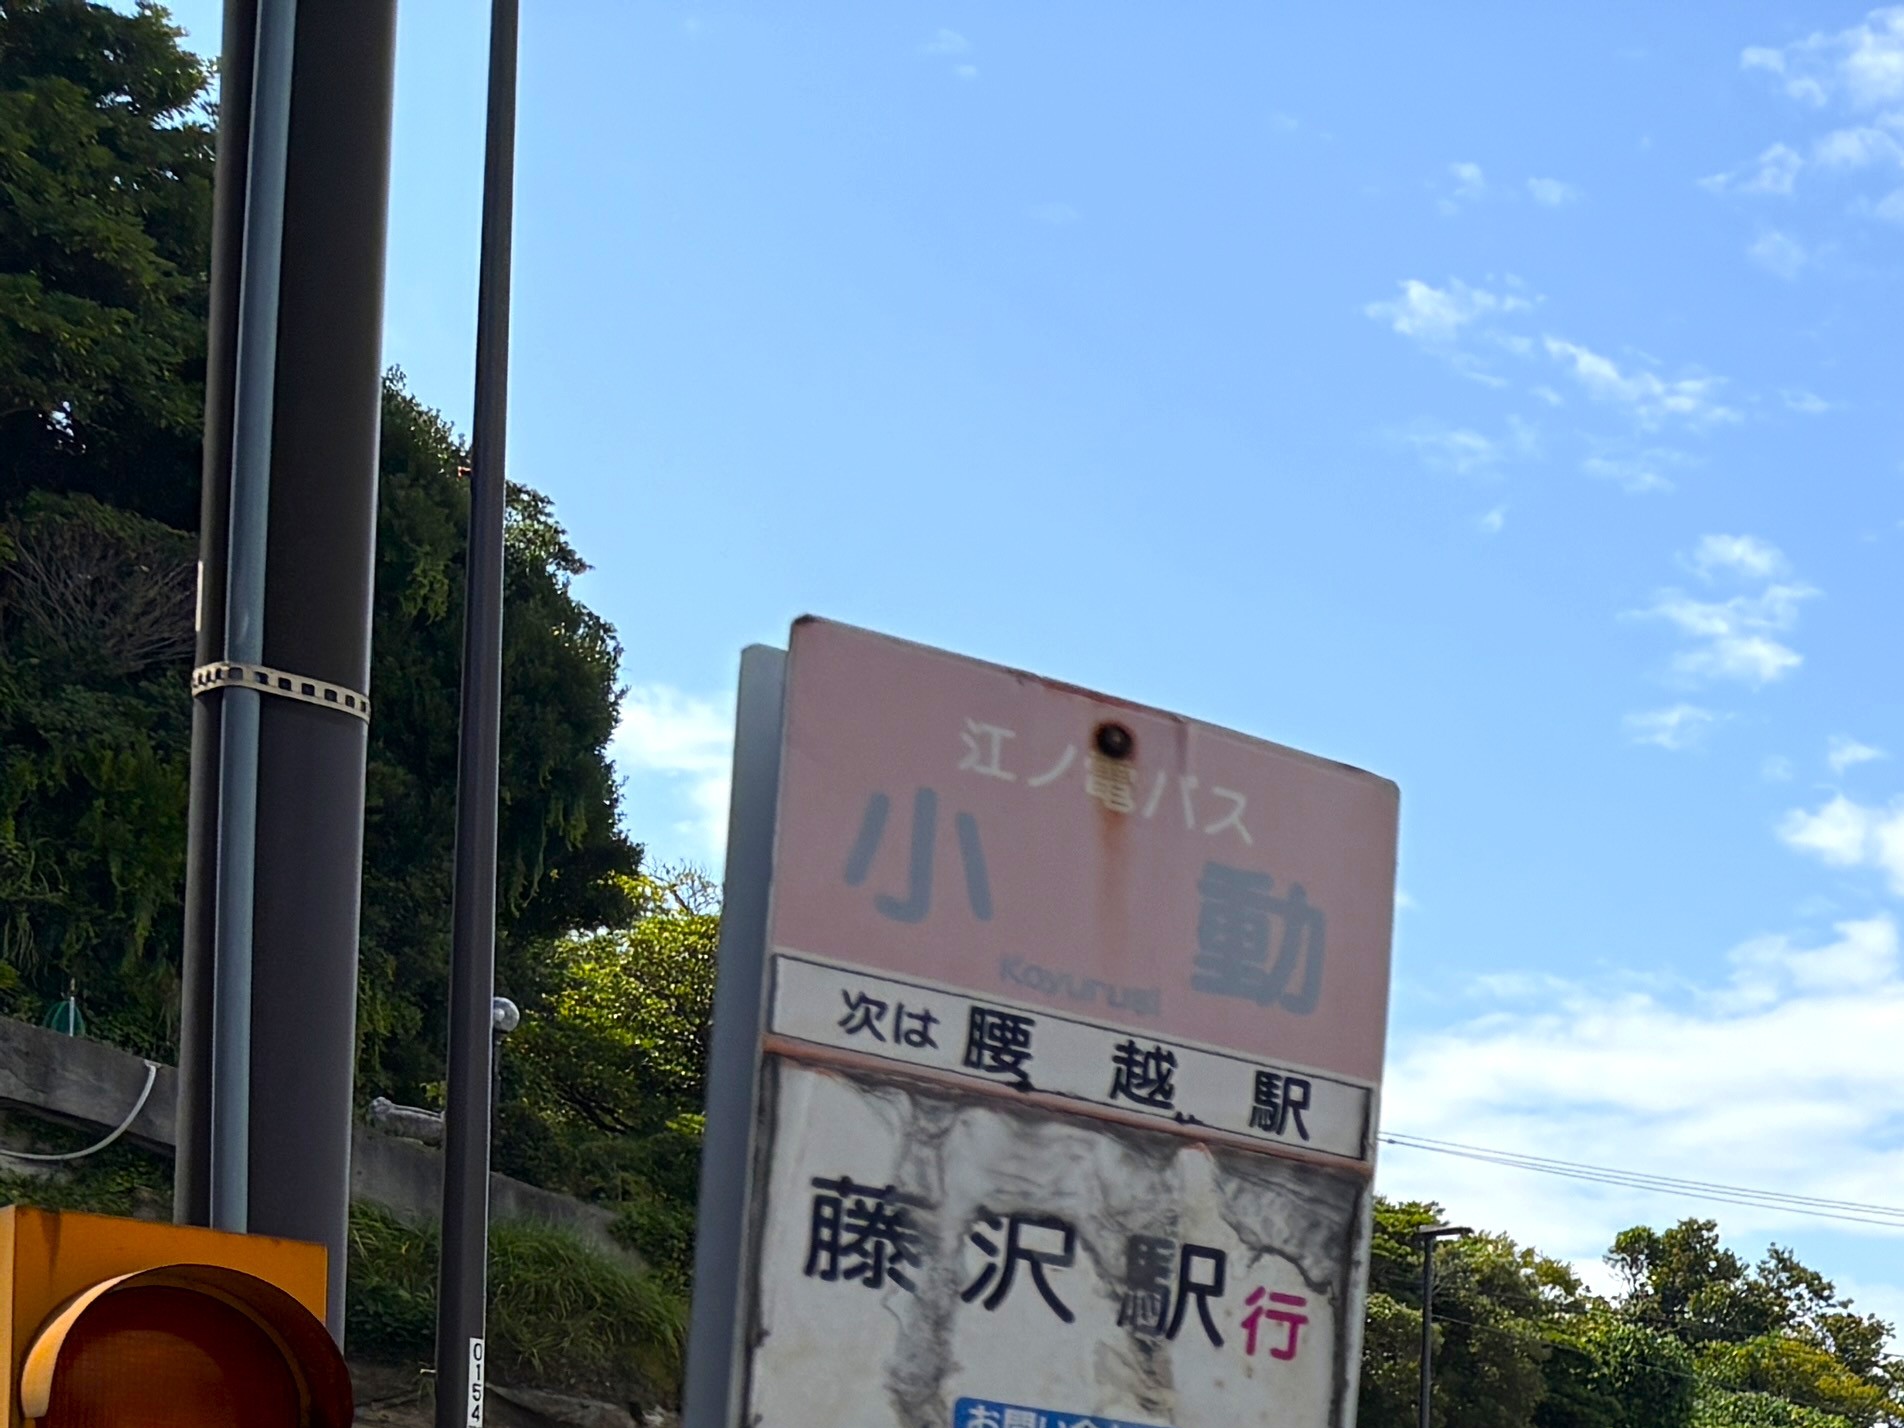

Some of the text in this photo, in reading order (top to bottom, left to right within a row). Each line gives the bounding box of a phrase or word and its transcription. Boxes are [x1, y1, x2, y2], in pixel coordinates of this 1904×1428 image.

[958, 717, 1254, 846] 江ノ電バス
[842, 786, 1328, 1016] 小動
[803, 1174, 1310, 1362] 藤沢駅行
[471, 1342, 483, 1422] 0154
